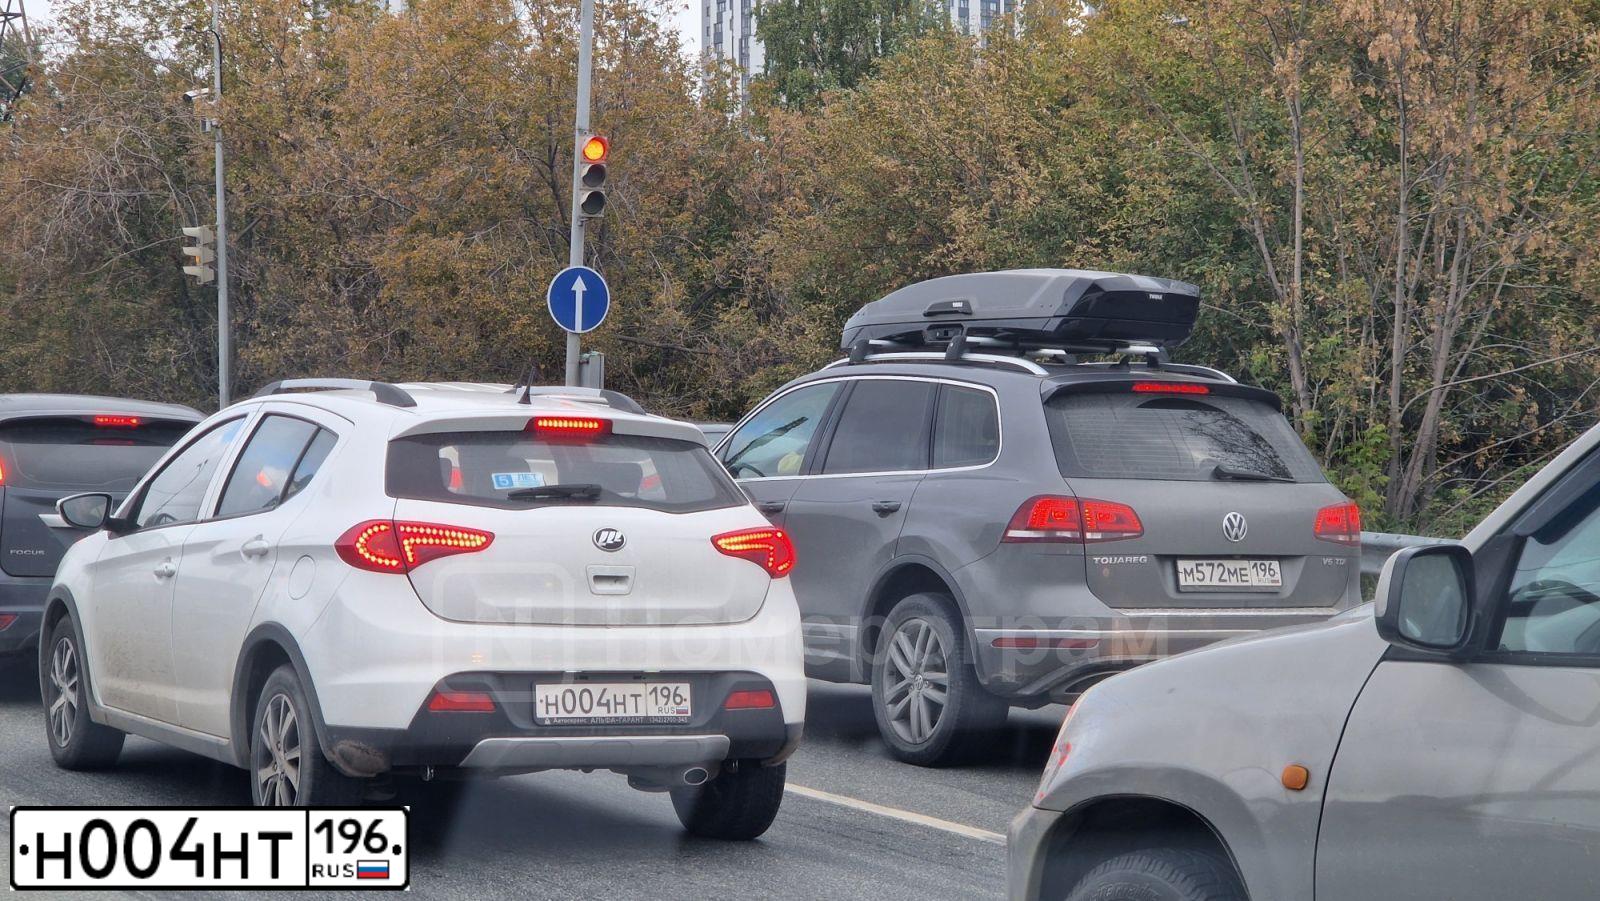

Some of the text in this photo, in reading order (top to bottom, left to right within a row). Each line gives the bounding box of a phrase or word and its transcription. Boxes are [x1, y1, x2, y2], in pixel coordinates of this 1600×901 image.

[1092, 556, 1148, 565] TOUAREG
[1252, 562, 1276, 577] 196
[545, 686, 684, 715] Н004НТ 196
[658, 707, 676, 715] RUS
